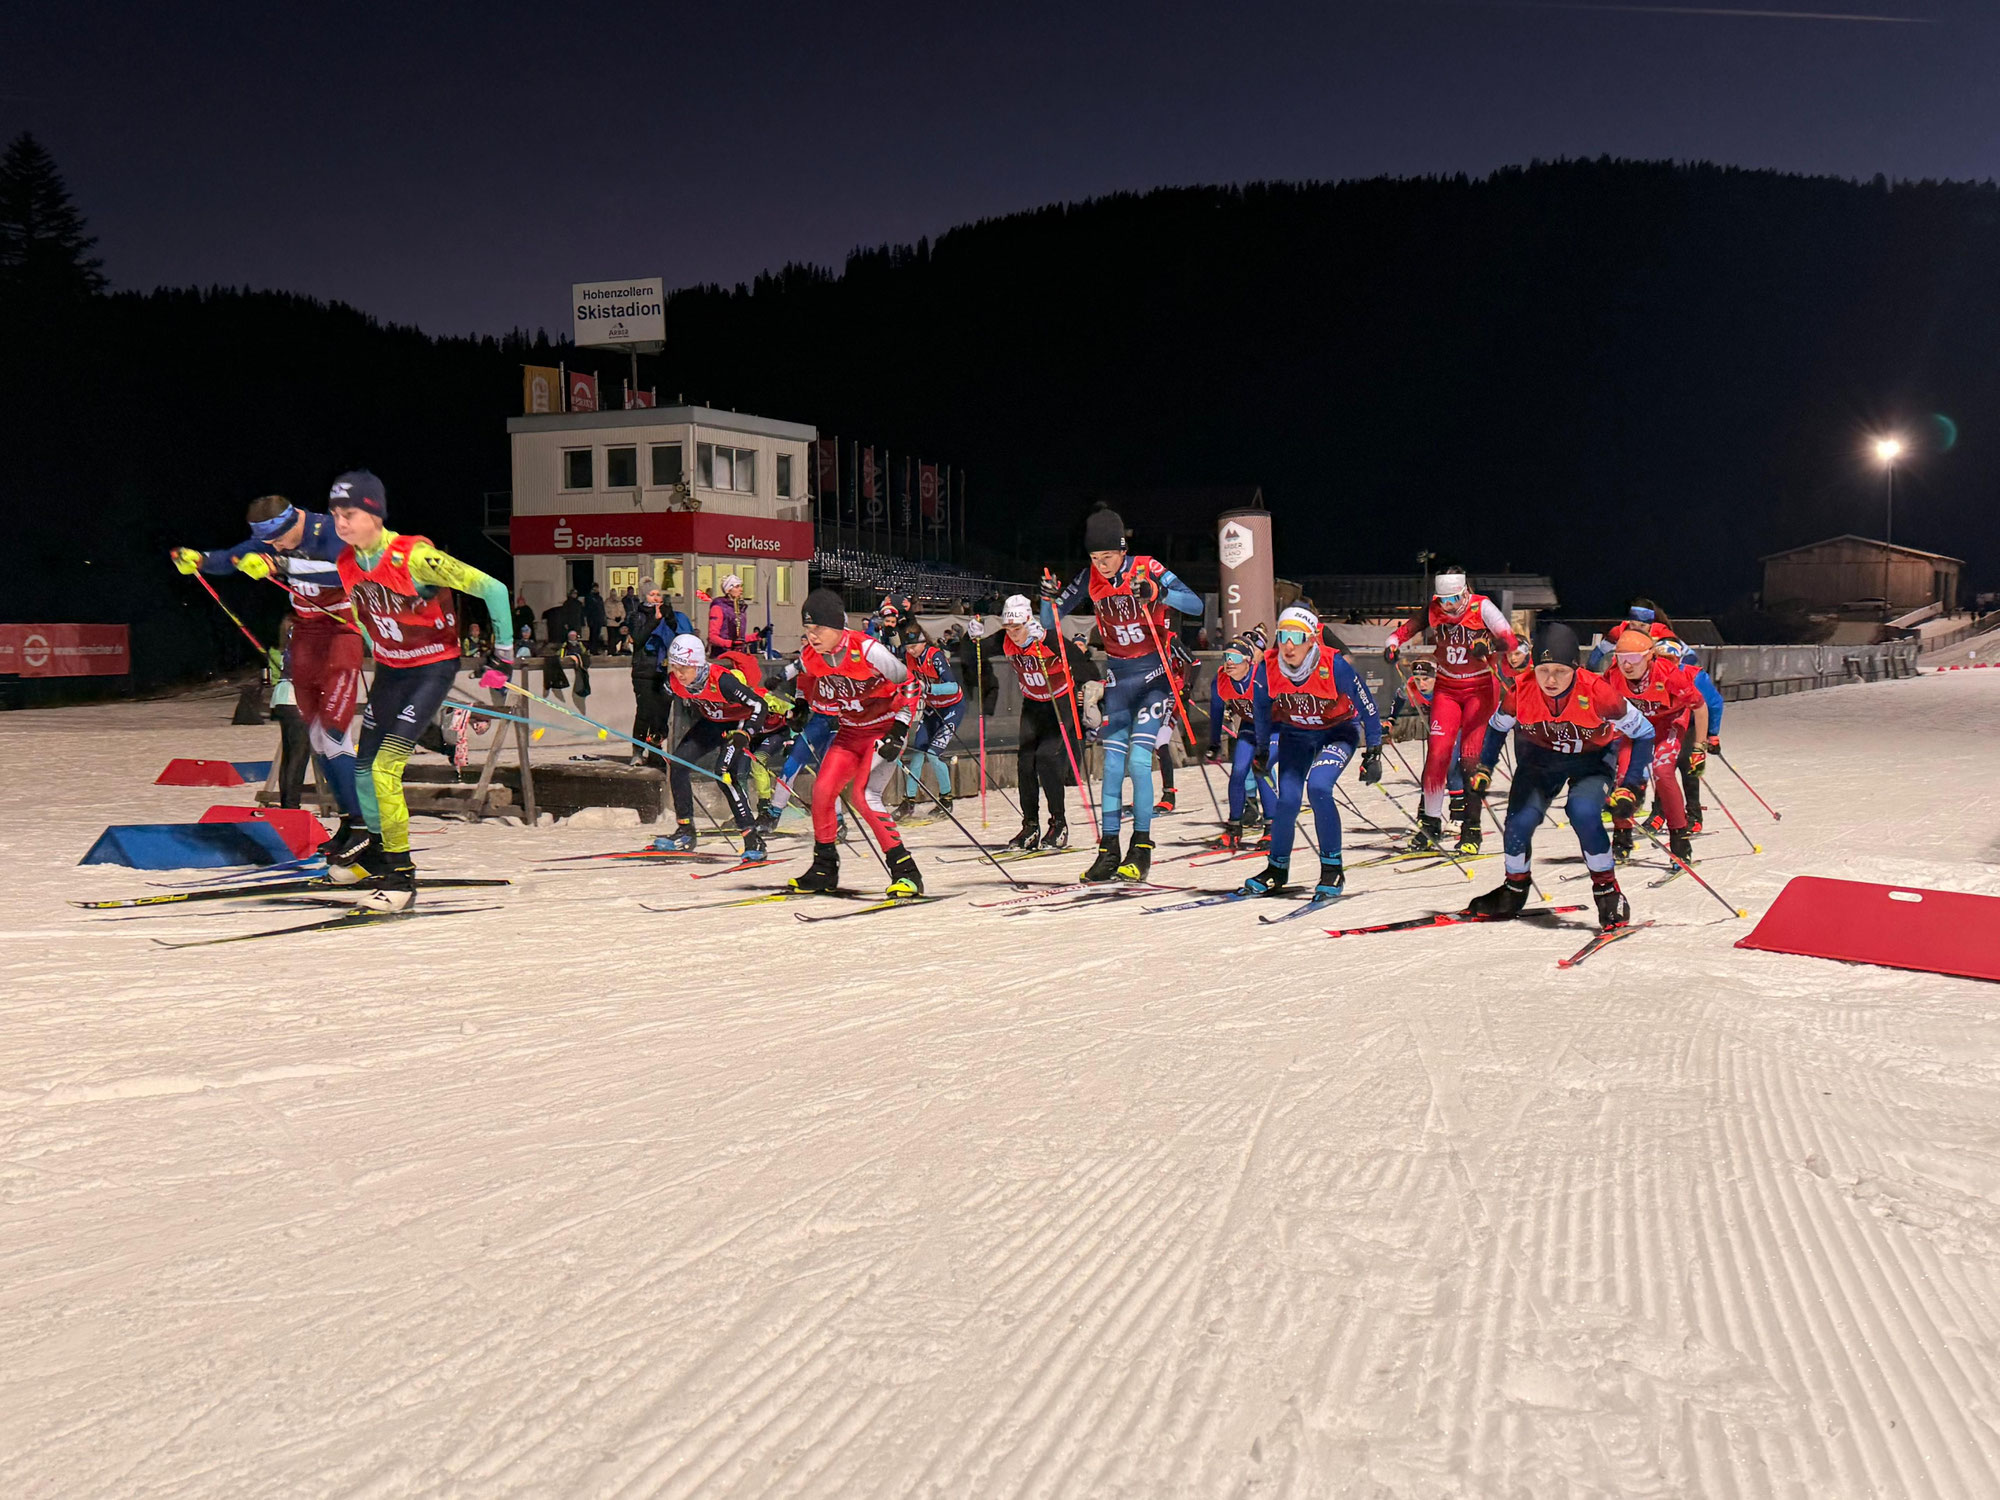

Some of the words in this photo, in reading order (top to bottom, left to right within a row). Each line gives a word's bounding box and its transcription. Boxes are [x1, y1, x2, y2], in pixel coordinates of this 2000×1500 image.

[583, 286, 654, 300] Hohenzollern
[577, 302, 661, 320] Skistadion
[576, 533, 643, 550] Sparkasse
[727, 534, 781, 551] Sparkasse
[1113, 623, 1146, 646] 55
[1446, 646, 1468, 665] 62
[1022, 672, 1046, 687] 60
[1144, 664, 1166, 684] swi
